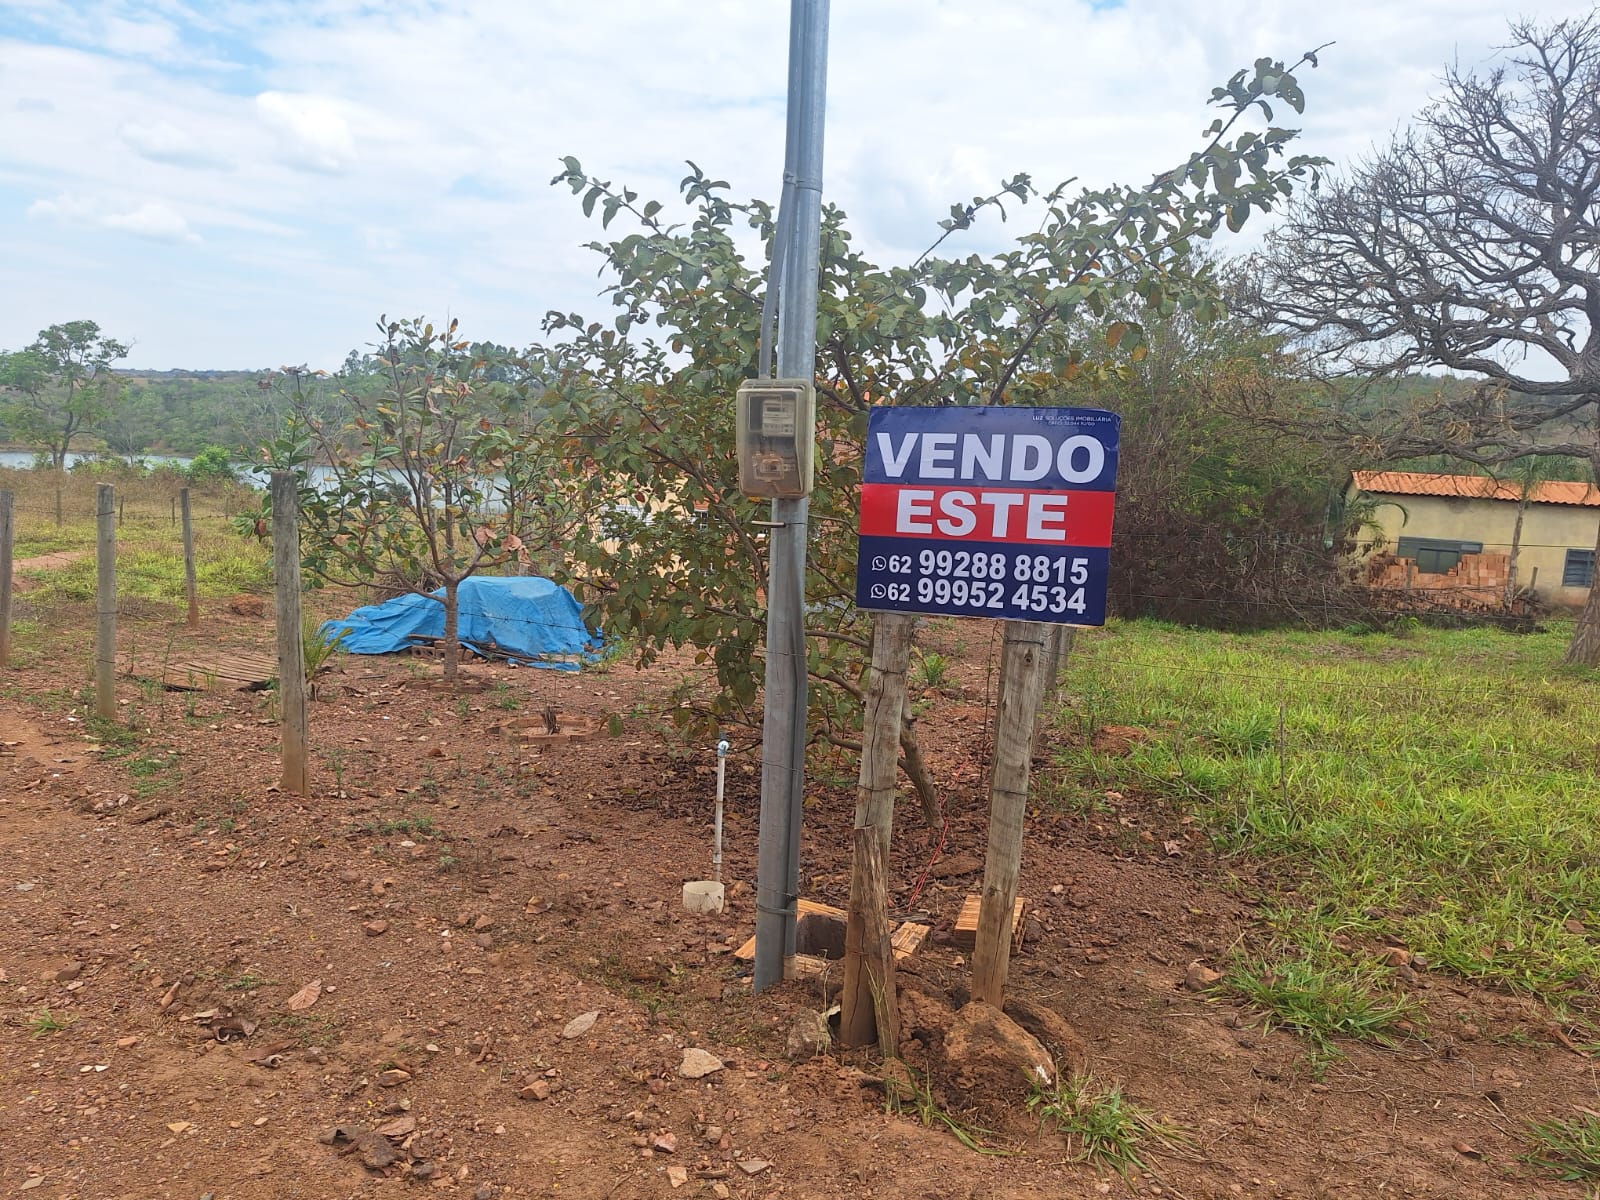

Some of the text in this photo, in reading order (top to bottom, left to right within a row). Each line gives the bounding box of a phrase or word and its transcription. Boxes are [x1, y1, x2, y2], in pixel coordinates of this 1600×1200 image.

[876, 432, 1105, 484] VENDO
[896, 489, 1068, 541] ESTE
[888, 549, 1089, 585] 62 99288 8815
[887, 577, 1087, 615] 62 99952 4534
